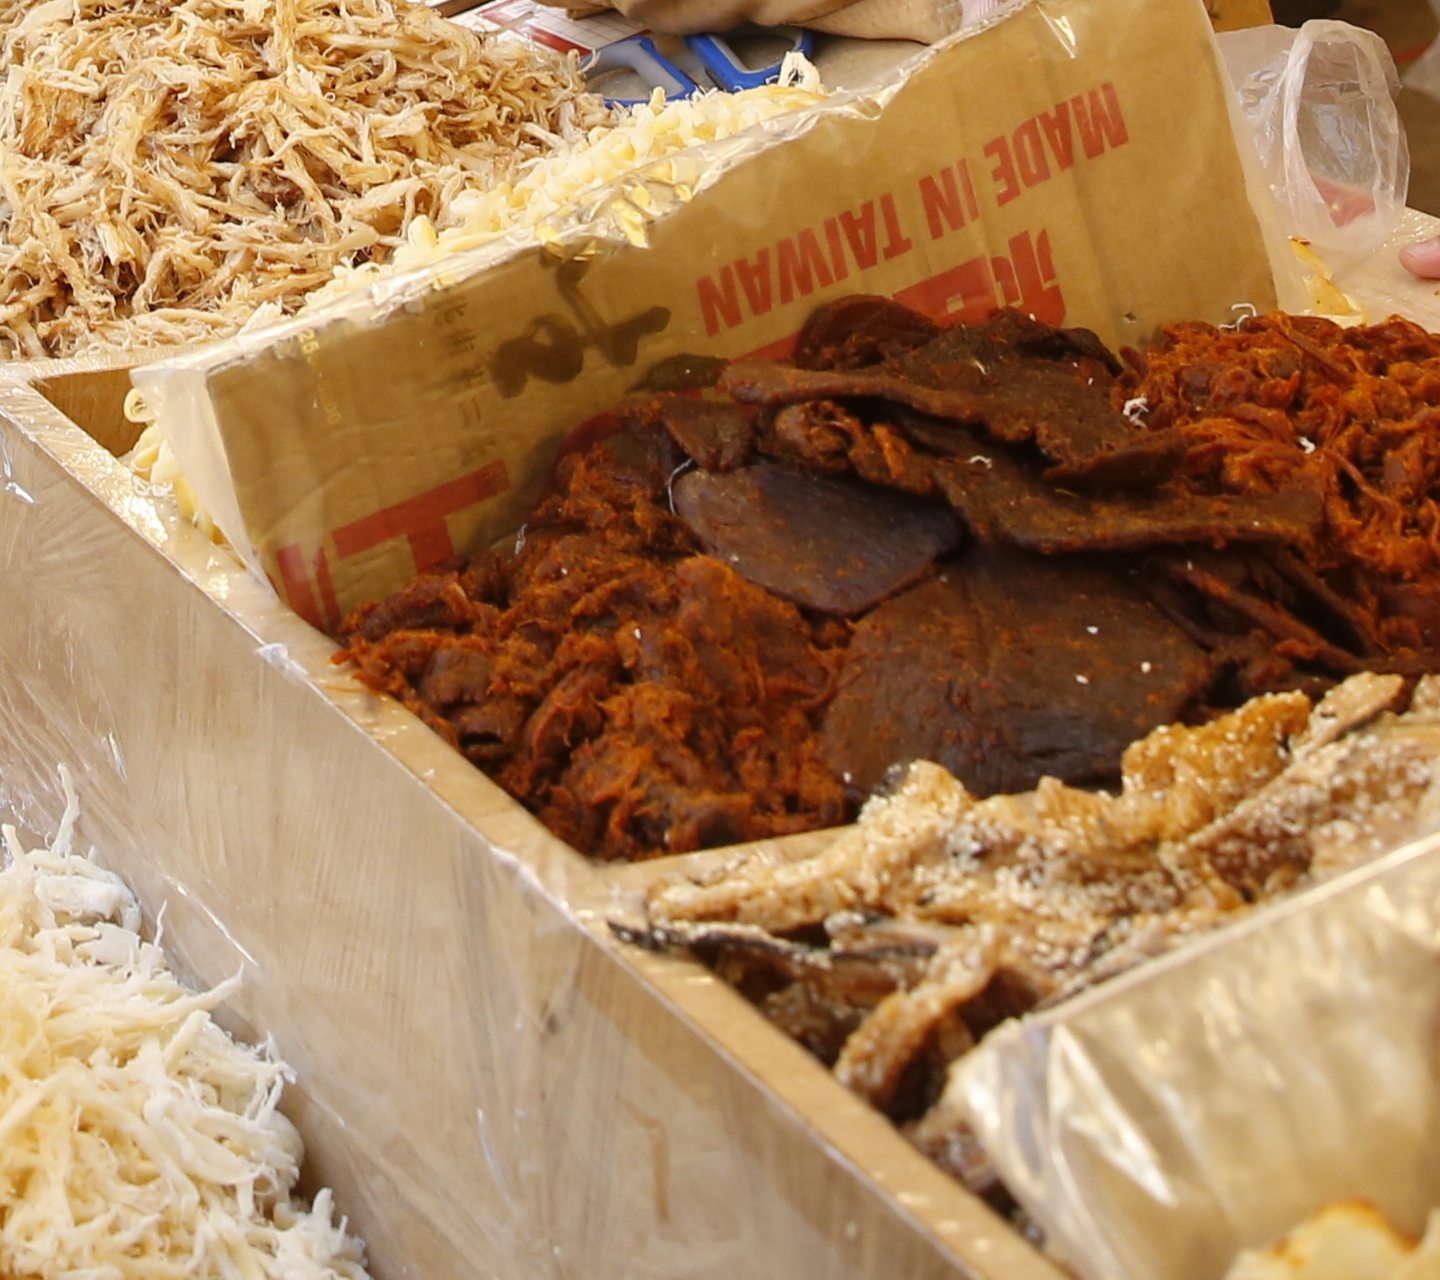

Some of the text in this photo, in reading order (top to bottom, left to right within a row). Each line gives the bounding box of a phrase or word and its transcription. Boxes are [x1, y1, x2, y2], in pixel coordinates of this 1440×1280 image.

[918, 157, 981, 241] IN
[982, 81, 1130, 208] MADE
[695, 192, 913, 338] TAIWAN
